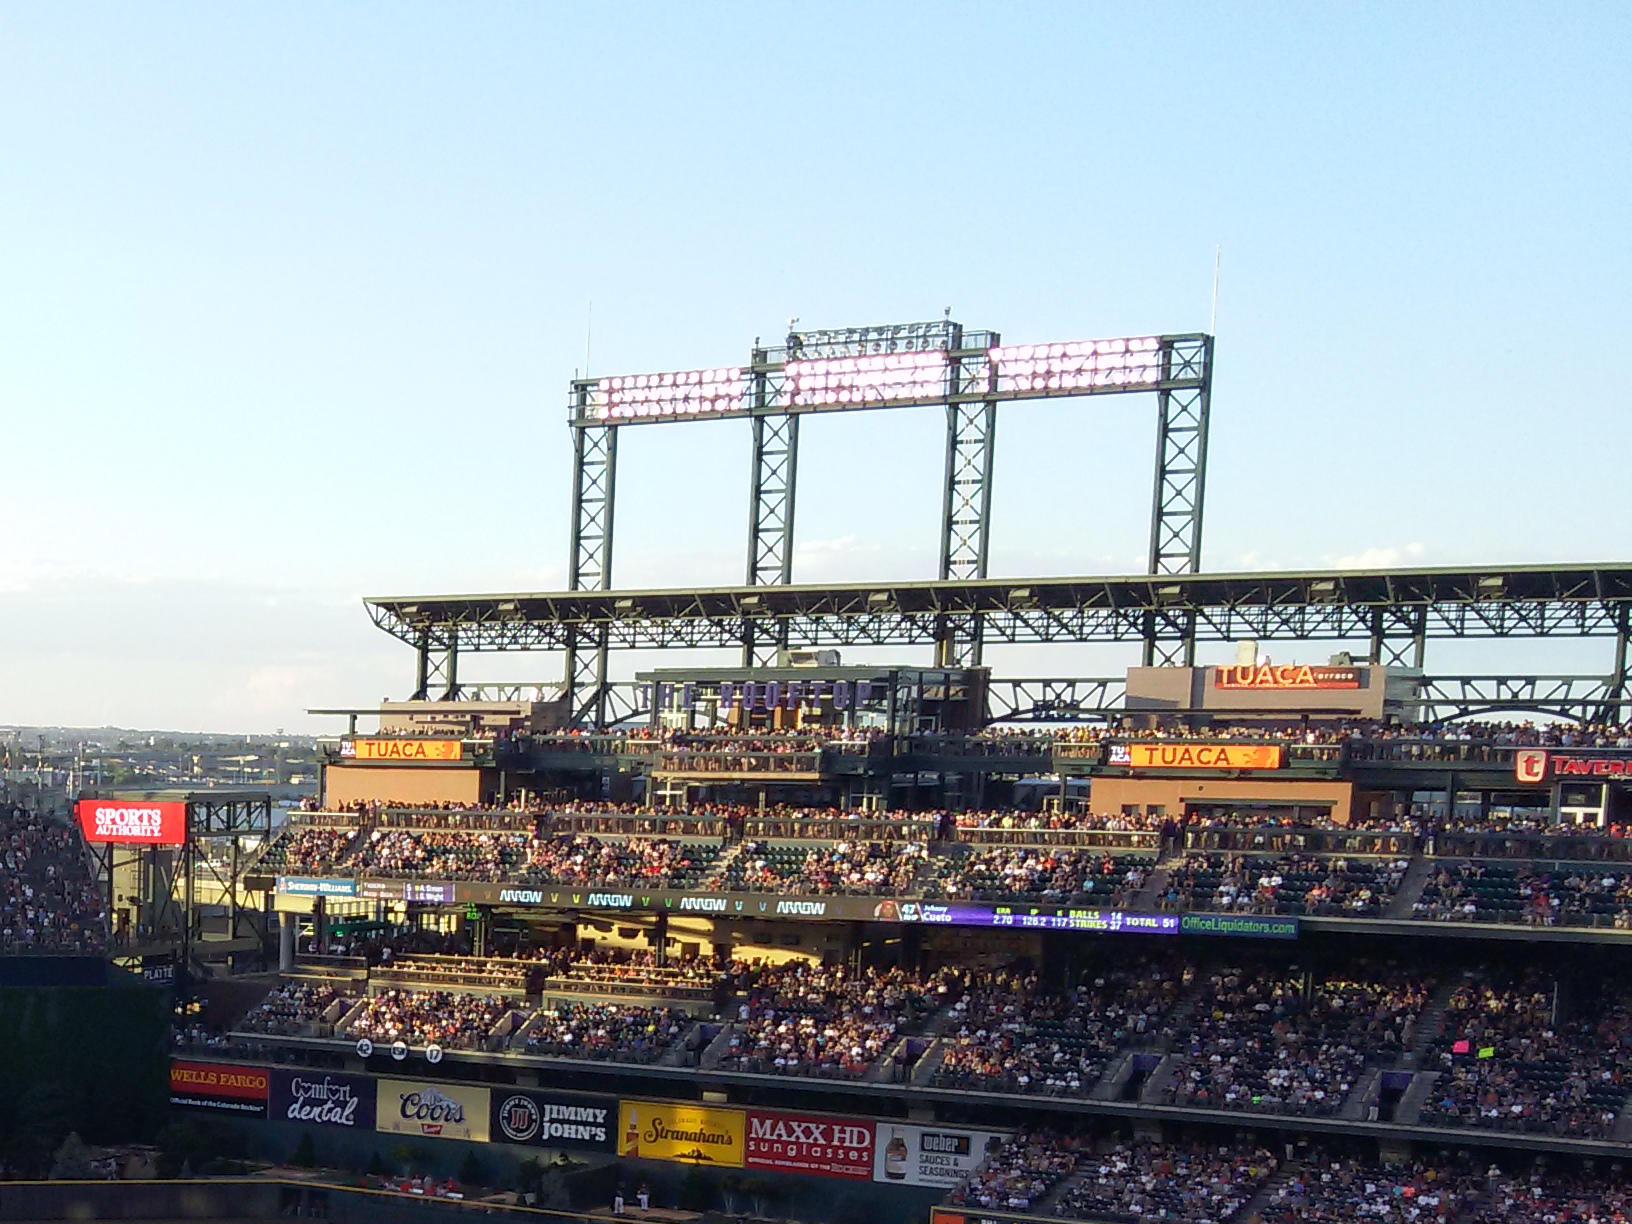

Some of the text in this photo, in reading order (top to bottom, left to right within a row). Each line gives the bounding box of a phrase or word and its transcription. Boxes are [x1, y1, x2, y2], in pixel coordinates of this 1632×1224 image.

[1218, 664, 1315, 684] TUACA
[638, 680, 873, 710] THE ROOFTOP
[365, 742, 427, 757] TUACA
[1145, 747, 1232, 765] TUACA
[95, 807, 162, 826] SPORTS
[901, 904, 916, 914] 47
[924, 912, 952, 922] Cueto
[1069, 910, 1099, 920] BALLS
[993, 915, 1067, 927] 2.70 126.2 117
[1069, 919, 1107, 930] STRIKES
[1125, 917, 1175, 928] TOTAL 51
[1182, 916, 1295, 934] OfficeLiquidators.com
[170, 1069, 267, 1089] WELLS FARGO
[292, 1076, 351, 1101] Comfort
[287, 1096, 358, 1125] dental
[399, 1092, 466, 1124] Coors
[543, 1103, 608, 1124] JIMMY
[542, 1122, 607, 1142] JOHN'S
[643, 1117, 734, 1146] Stranahan's
[749, 1117, 827, 1145] MAXX
[831, 1125, 871, 1148] HD
[748, 1140, 869, 1162] sunglasses
[923, 1134, 959, 1151] weber
[919, 1154, 959, 1167] SAUCES &
[919, 1165, 970, 1178] SEASONINGS
